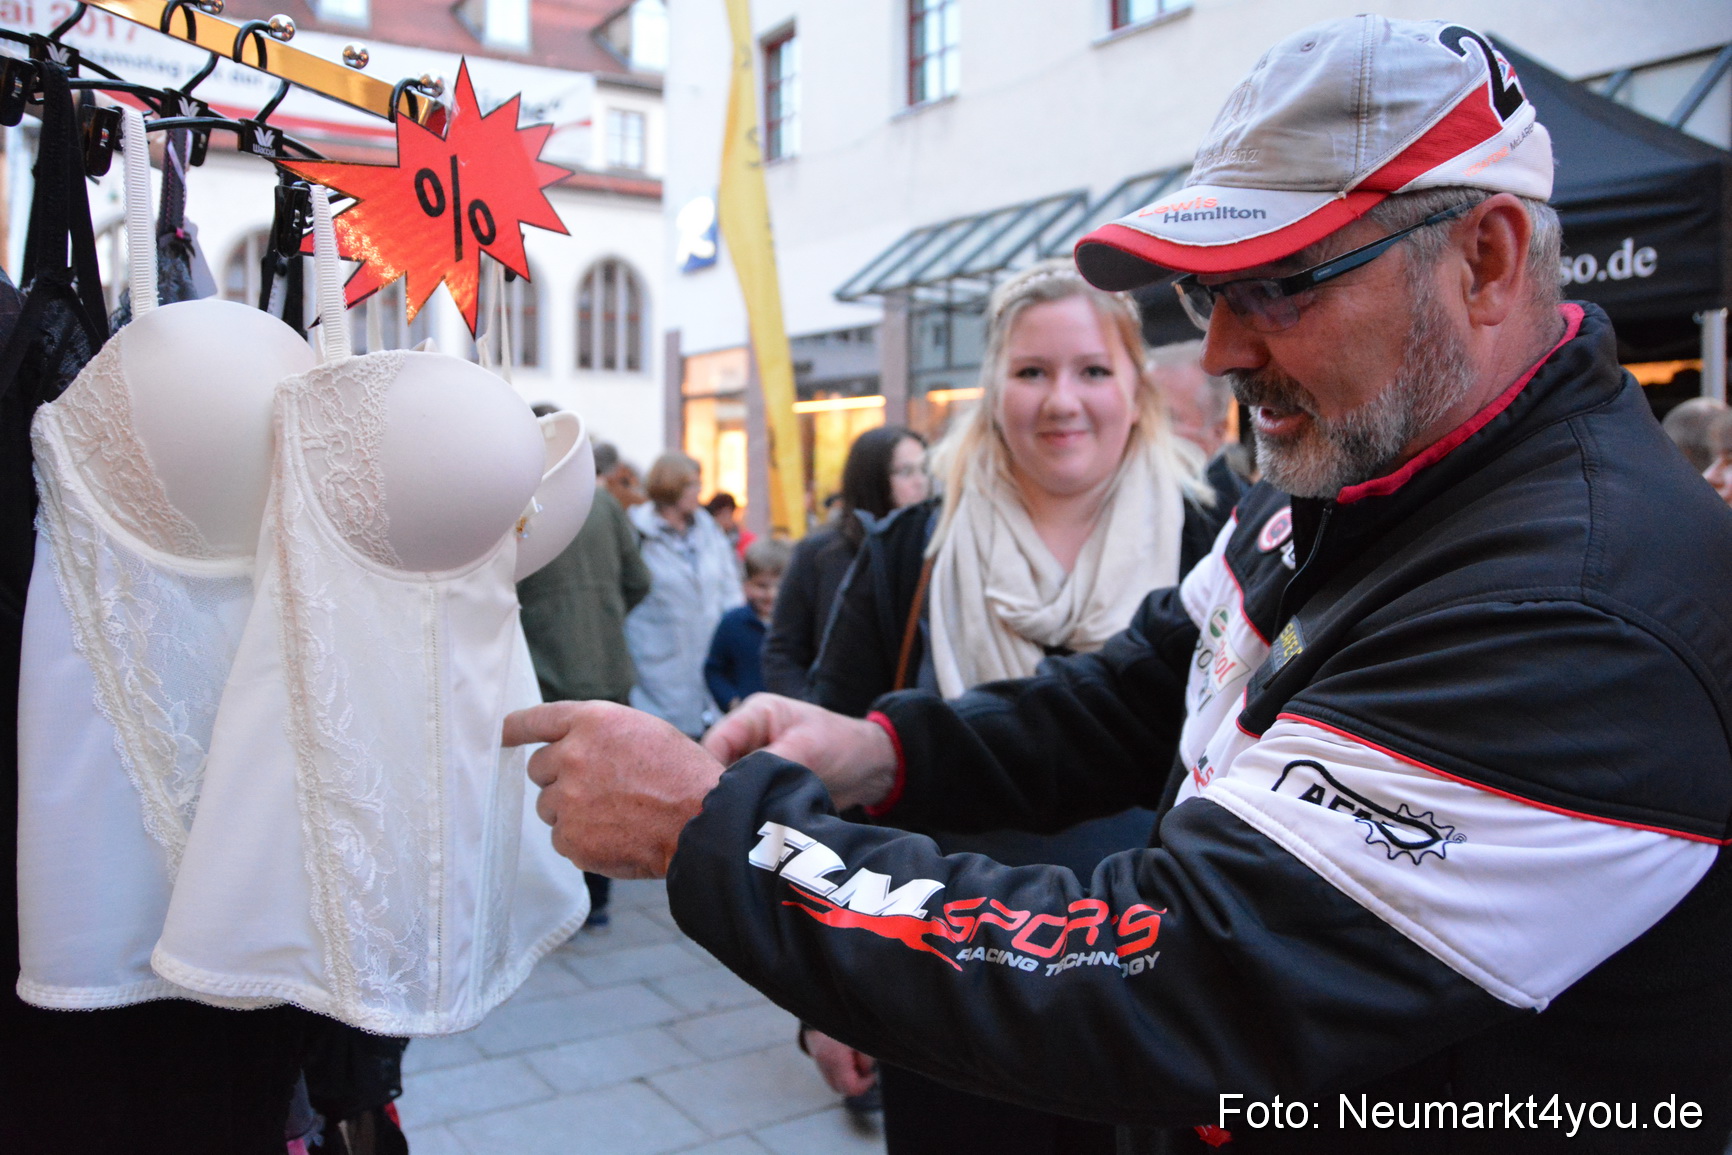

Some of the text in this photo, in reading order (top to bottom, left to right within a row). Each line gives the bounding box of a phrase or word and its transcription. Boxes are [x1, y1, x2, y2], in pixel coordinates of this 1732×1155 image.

[414, 154, 497, 262] %
[1138, 196, 1219, 218] Lewis
[1163, 205, 1267, 224] Hamilton
